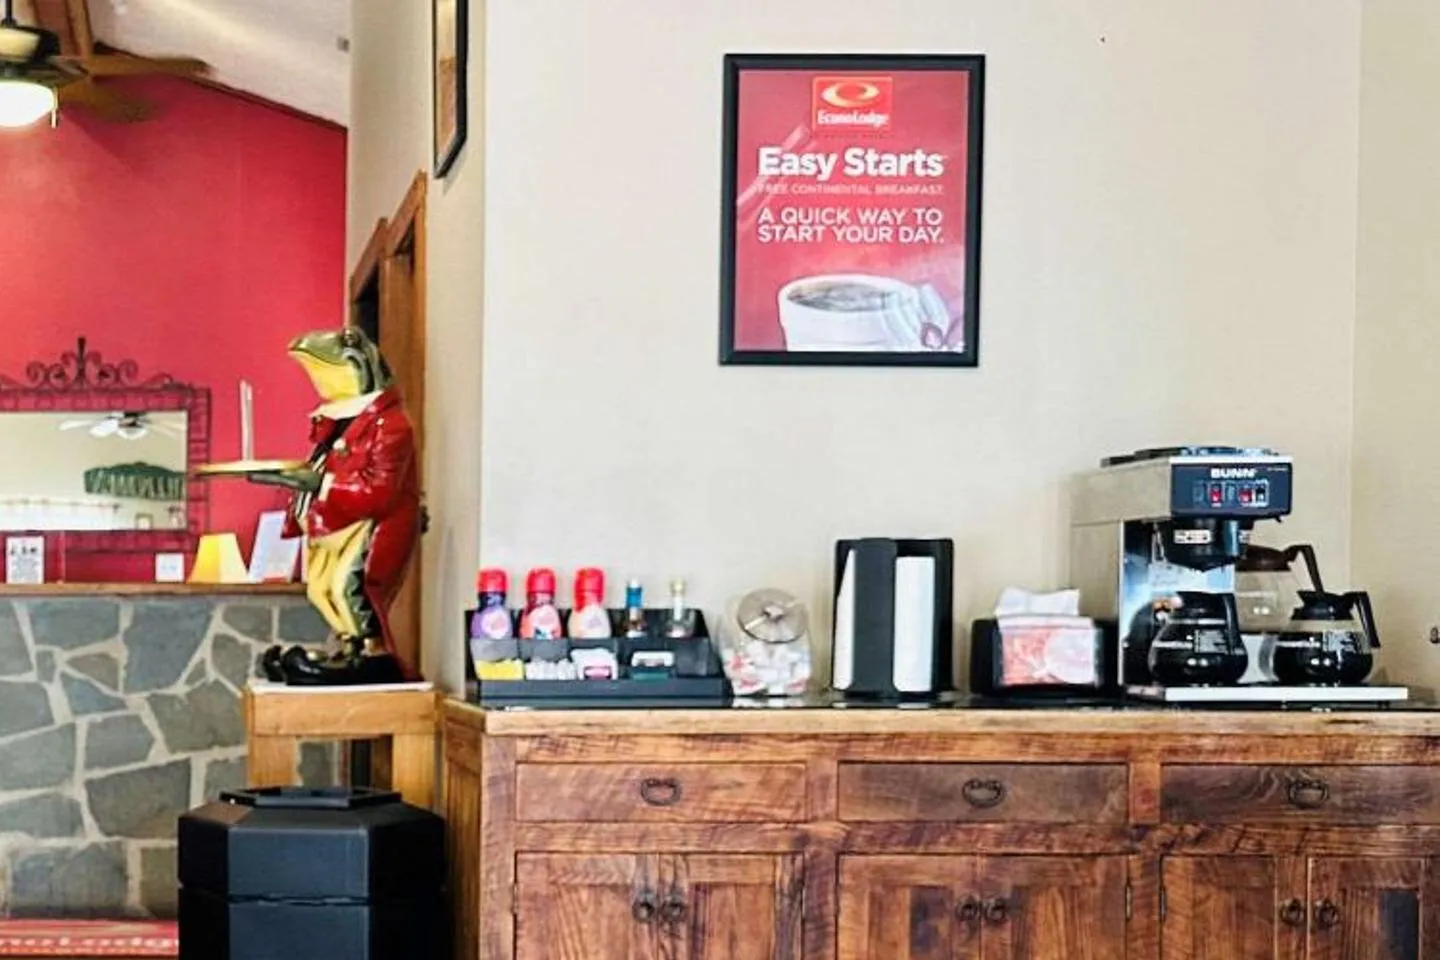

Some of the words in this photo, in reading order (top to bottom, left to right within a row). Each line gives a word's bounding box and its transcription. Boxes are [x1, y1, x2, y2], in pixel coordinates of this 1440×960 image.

[758, 146, 838, 181] Easy
[843, 147, 944, 177] Starts
[791, 184, 872, 196] CONTINENTAL
[758, 207, 774, 224] A
[781, 207, 851, 225] QUICK
[857, 208, 906, 225] WAY
[914, 207, 943, 225] TO
[758, 225, 826, 243] START
[832, 225, 893, 243] YOUR
[898, 226, 945, 243] DAY.
[1210, 467, 1256, 479] BUNN
